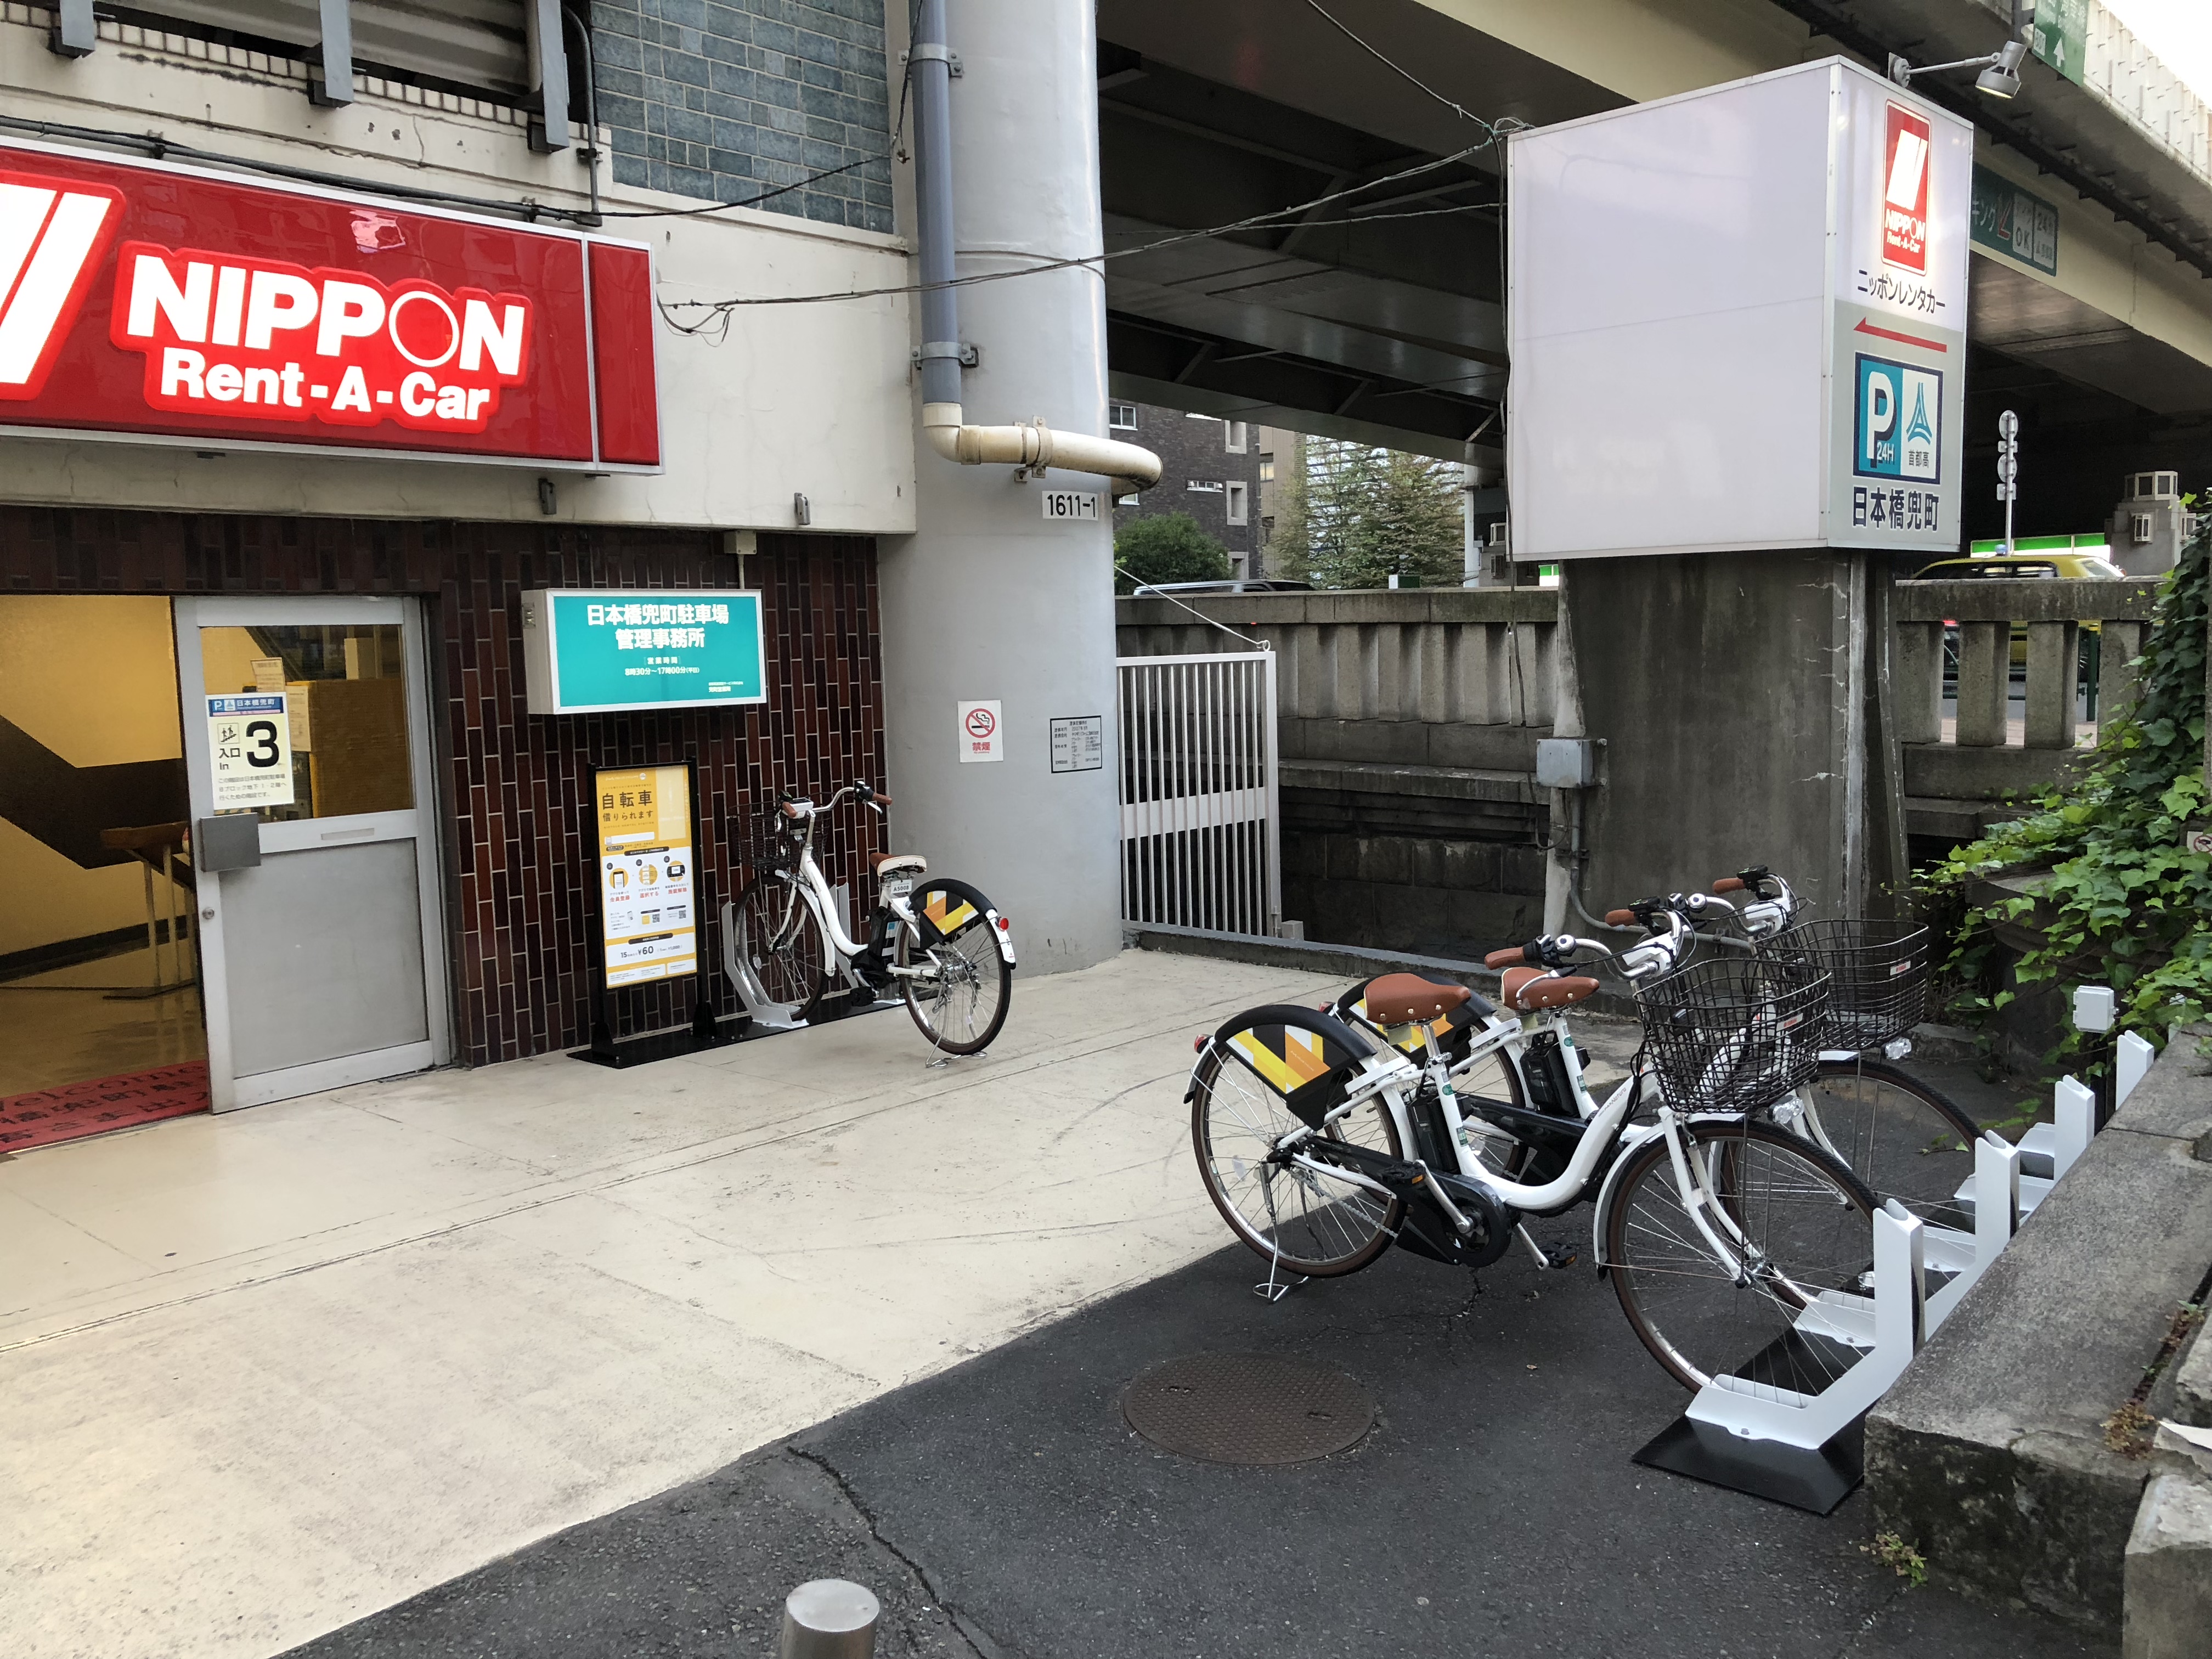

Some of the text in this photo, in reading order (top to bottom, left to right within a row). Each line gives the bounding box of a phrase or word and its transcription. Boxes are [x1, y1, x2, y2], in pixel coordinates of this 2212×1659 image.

[1885, 208, 1926, 241] NIPPON
[1887, 231, 1921, 253] Rent-A-Car
[1858, 269, 1946, 314] ニッポンレンタカー
[127, 254, 526, 376] NIPPON
[161, 348, 490, 421] Rent-A-Car
[1866, 371, 1897, 460] P
[1876, 441, 1895, 462] 24H
[1908, 449, 1929, 468] 首都高
[1047, 494, 1096, 517] 1611-1
[1853, 486, 1939, 532] 日本橋兜町
[587, 604, 729, 626] 日本橋兜町駐車場
[615, 627, 705, 650] 管理事務所
[218, 748, 240, 759] 入口
[246, 720, 279, 768] 3
[972, 742, 990, 751] 禁煙
[219, 762, 229, 770] In
[602, 790, 653, 810] 自転車
[602, 810, 653, 822] 借りられます
[0, 1066, 207, 1111] elcome
